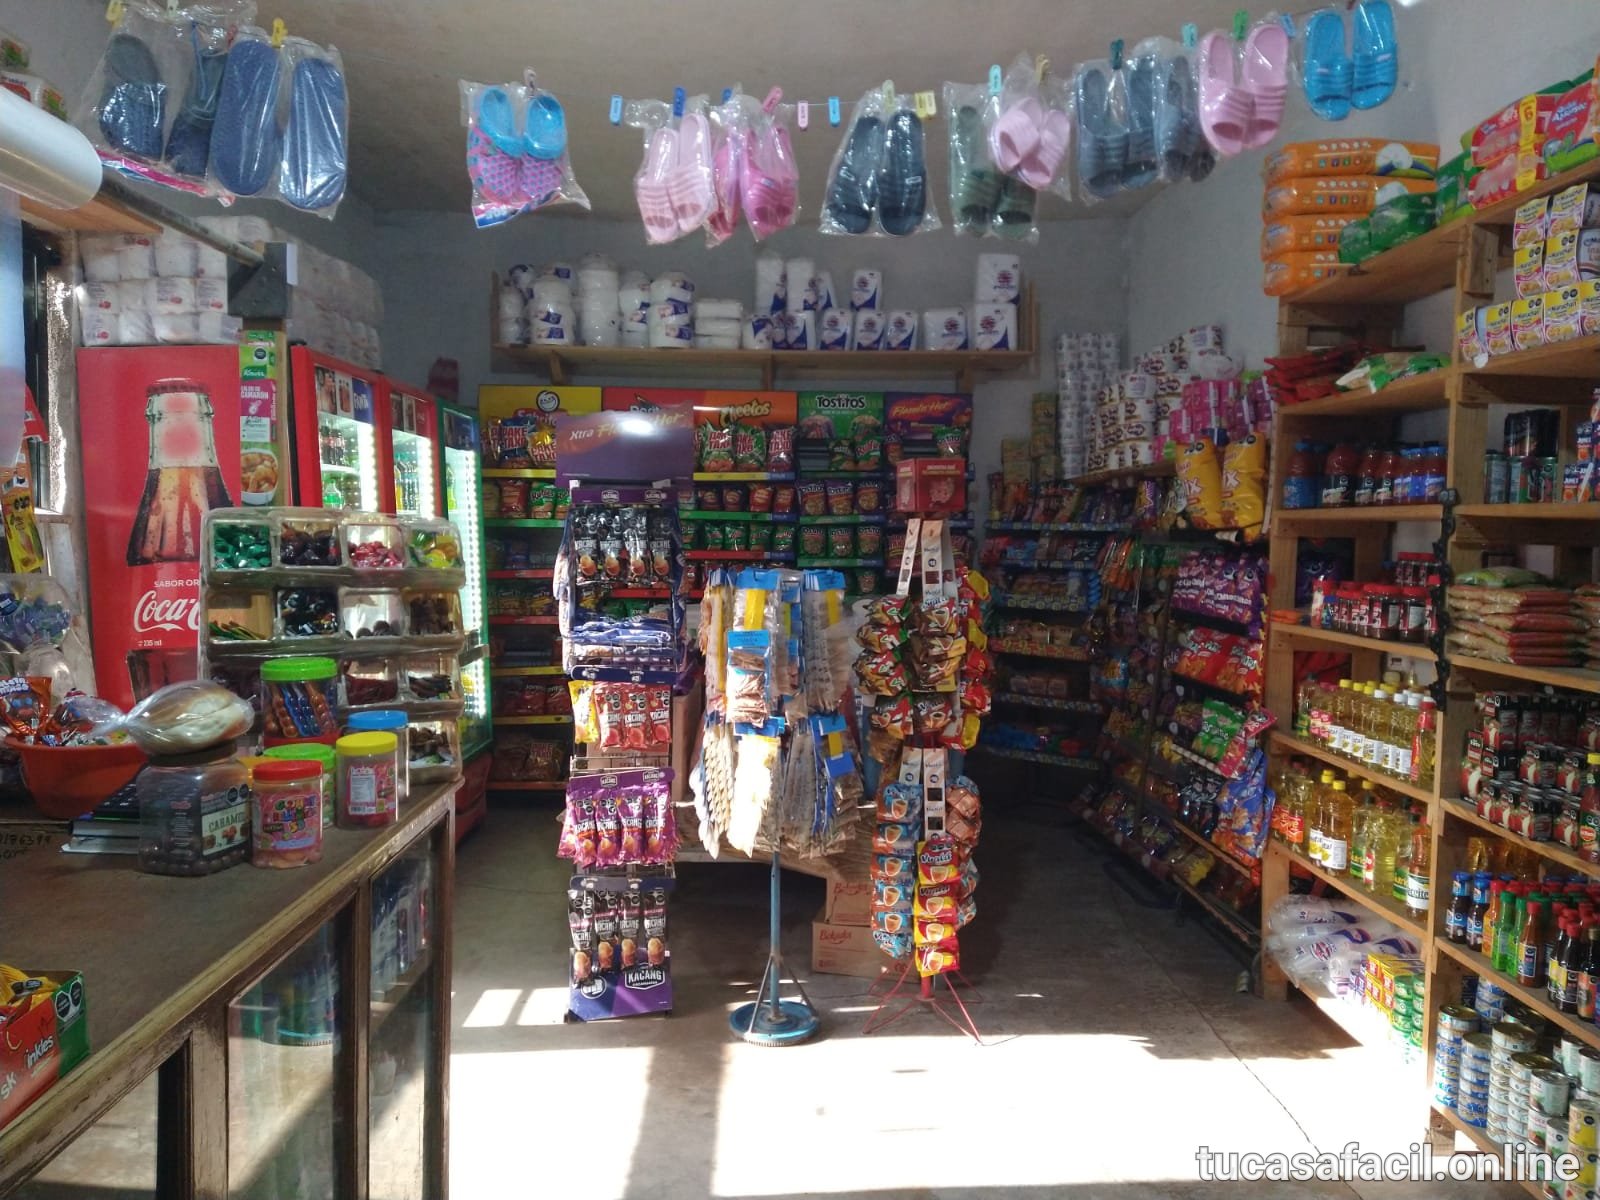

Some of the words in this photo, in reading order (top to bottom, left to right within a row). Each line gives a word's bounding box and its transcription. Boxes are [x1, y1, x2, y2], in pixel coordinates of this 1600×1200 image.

[719, 399, 772, 427] Cheetos
[569, 429, 595, 441] Xtra
[154, 580, 184, 588] SABOR
[133, 590, 200, 633] Coca-C
[628, 969, 662, 984] KACANG
